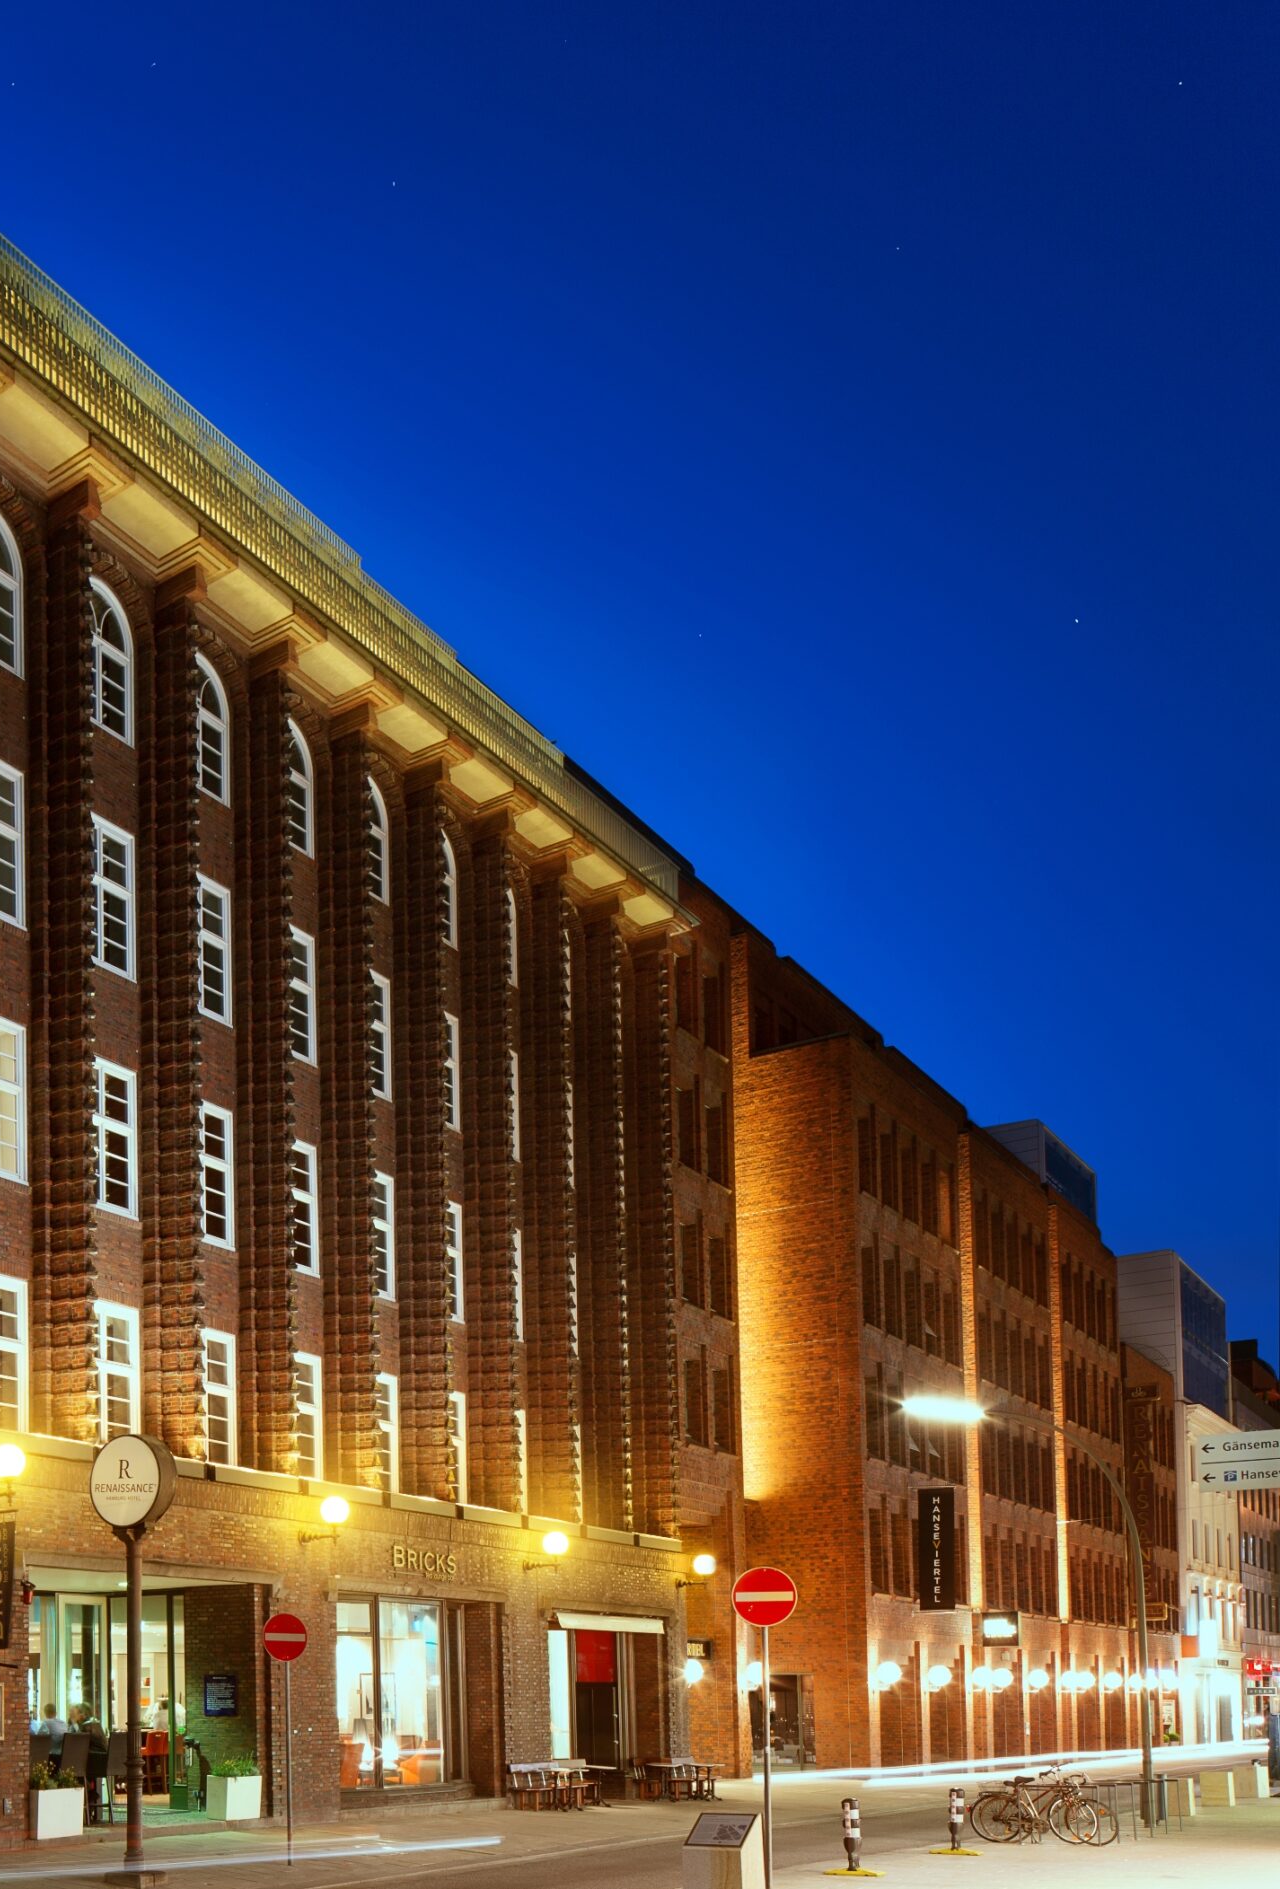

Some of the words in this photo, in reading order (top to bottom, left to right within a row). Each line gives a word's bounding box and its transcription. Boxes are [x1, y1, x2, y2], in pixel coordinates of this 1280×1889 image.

[1222, 1440, 1280, 1452] Gänsema
[118, 1459, 132, 1479] R
[95, 1483, 154, 1493] RENAISSANCE
[393, 1545, 456, 1574] BRICKS
[932, 1496, 941, 1603] HANSEVIERTEL
